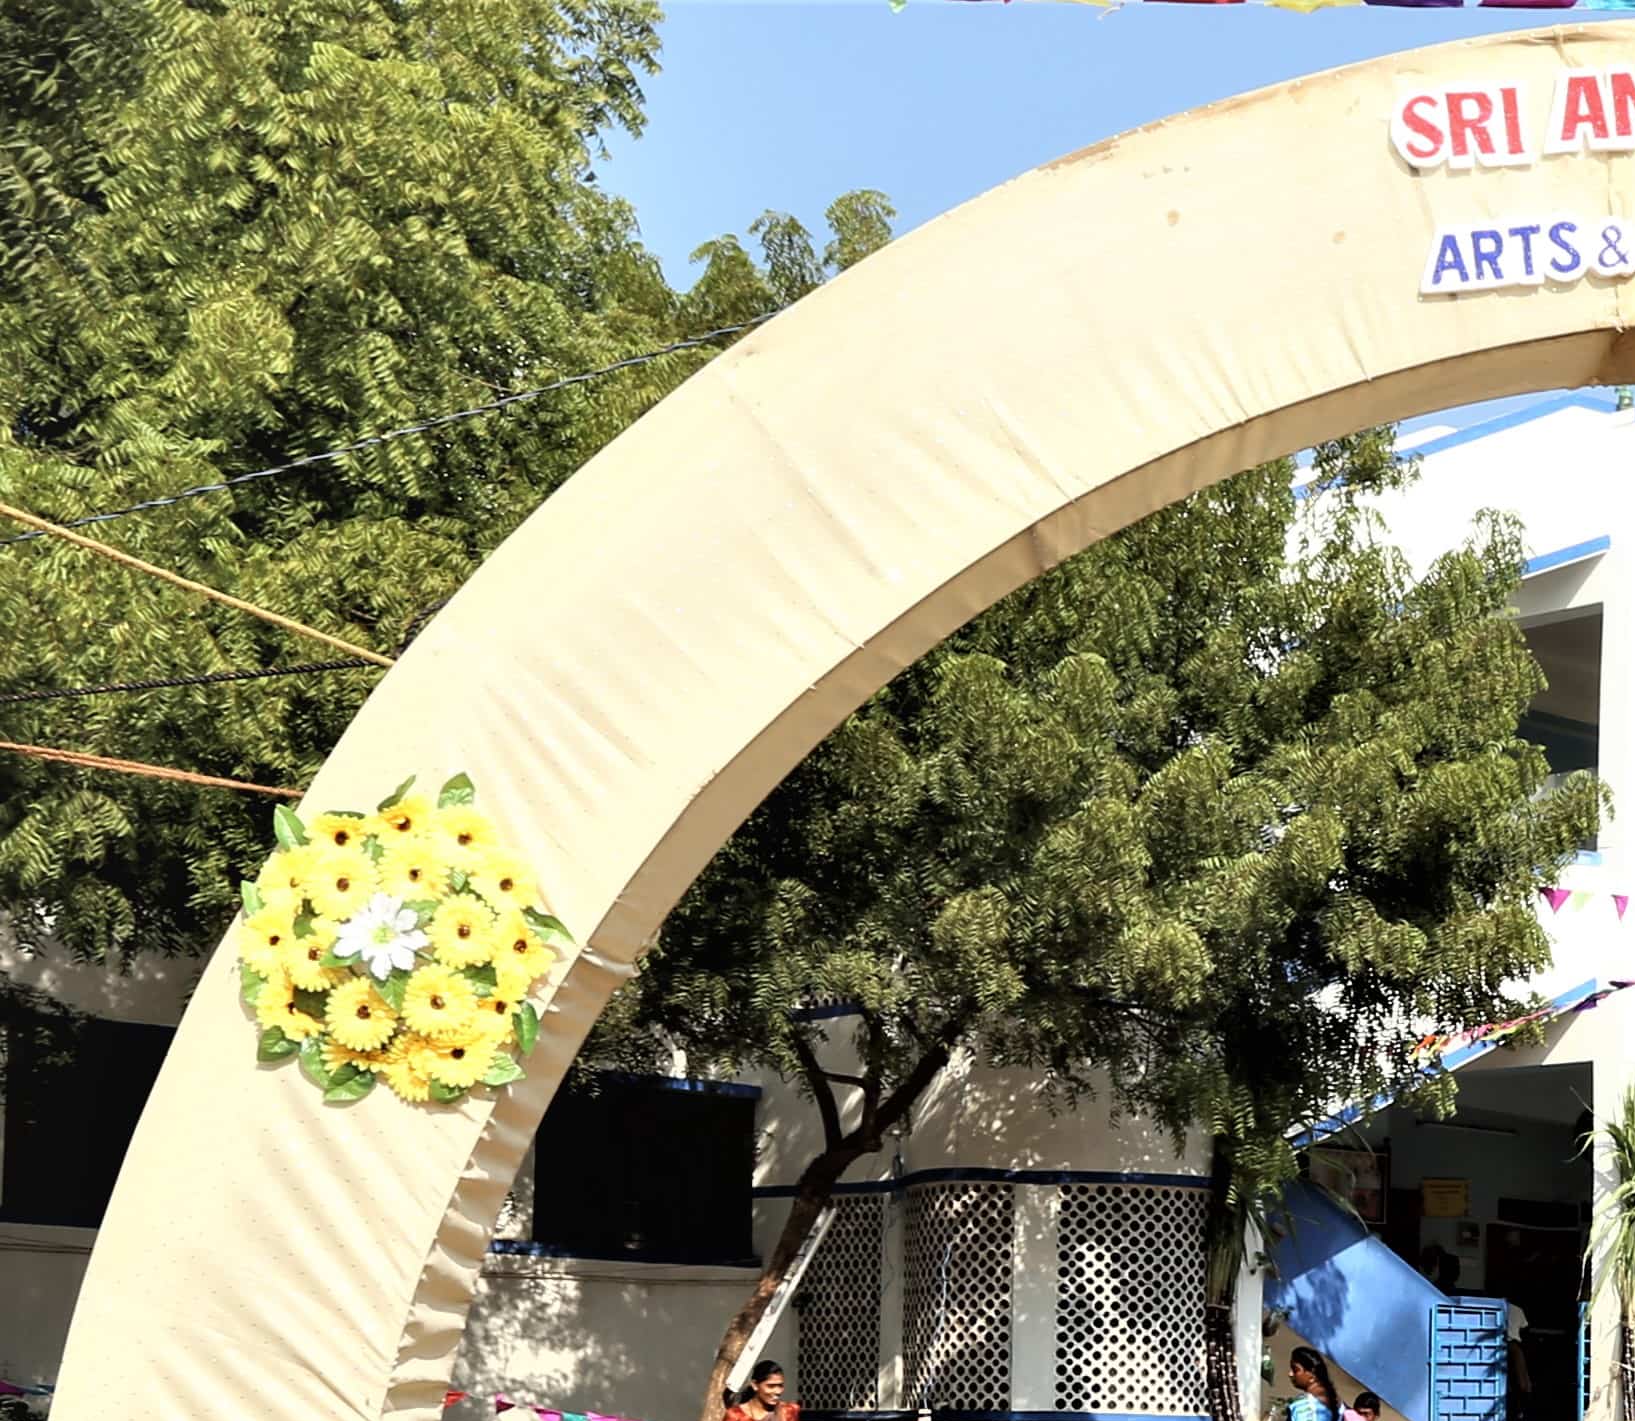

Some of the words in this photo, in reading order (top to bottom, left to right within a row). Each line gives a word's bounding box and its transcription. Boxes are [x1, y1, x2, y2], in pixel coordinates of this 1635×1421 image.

[1403, 88, 1522, 158] SRI
[1432, 221, 1581, 284] ARTS
[1598, 226, 1631, 268] &
